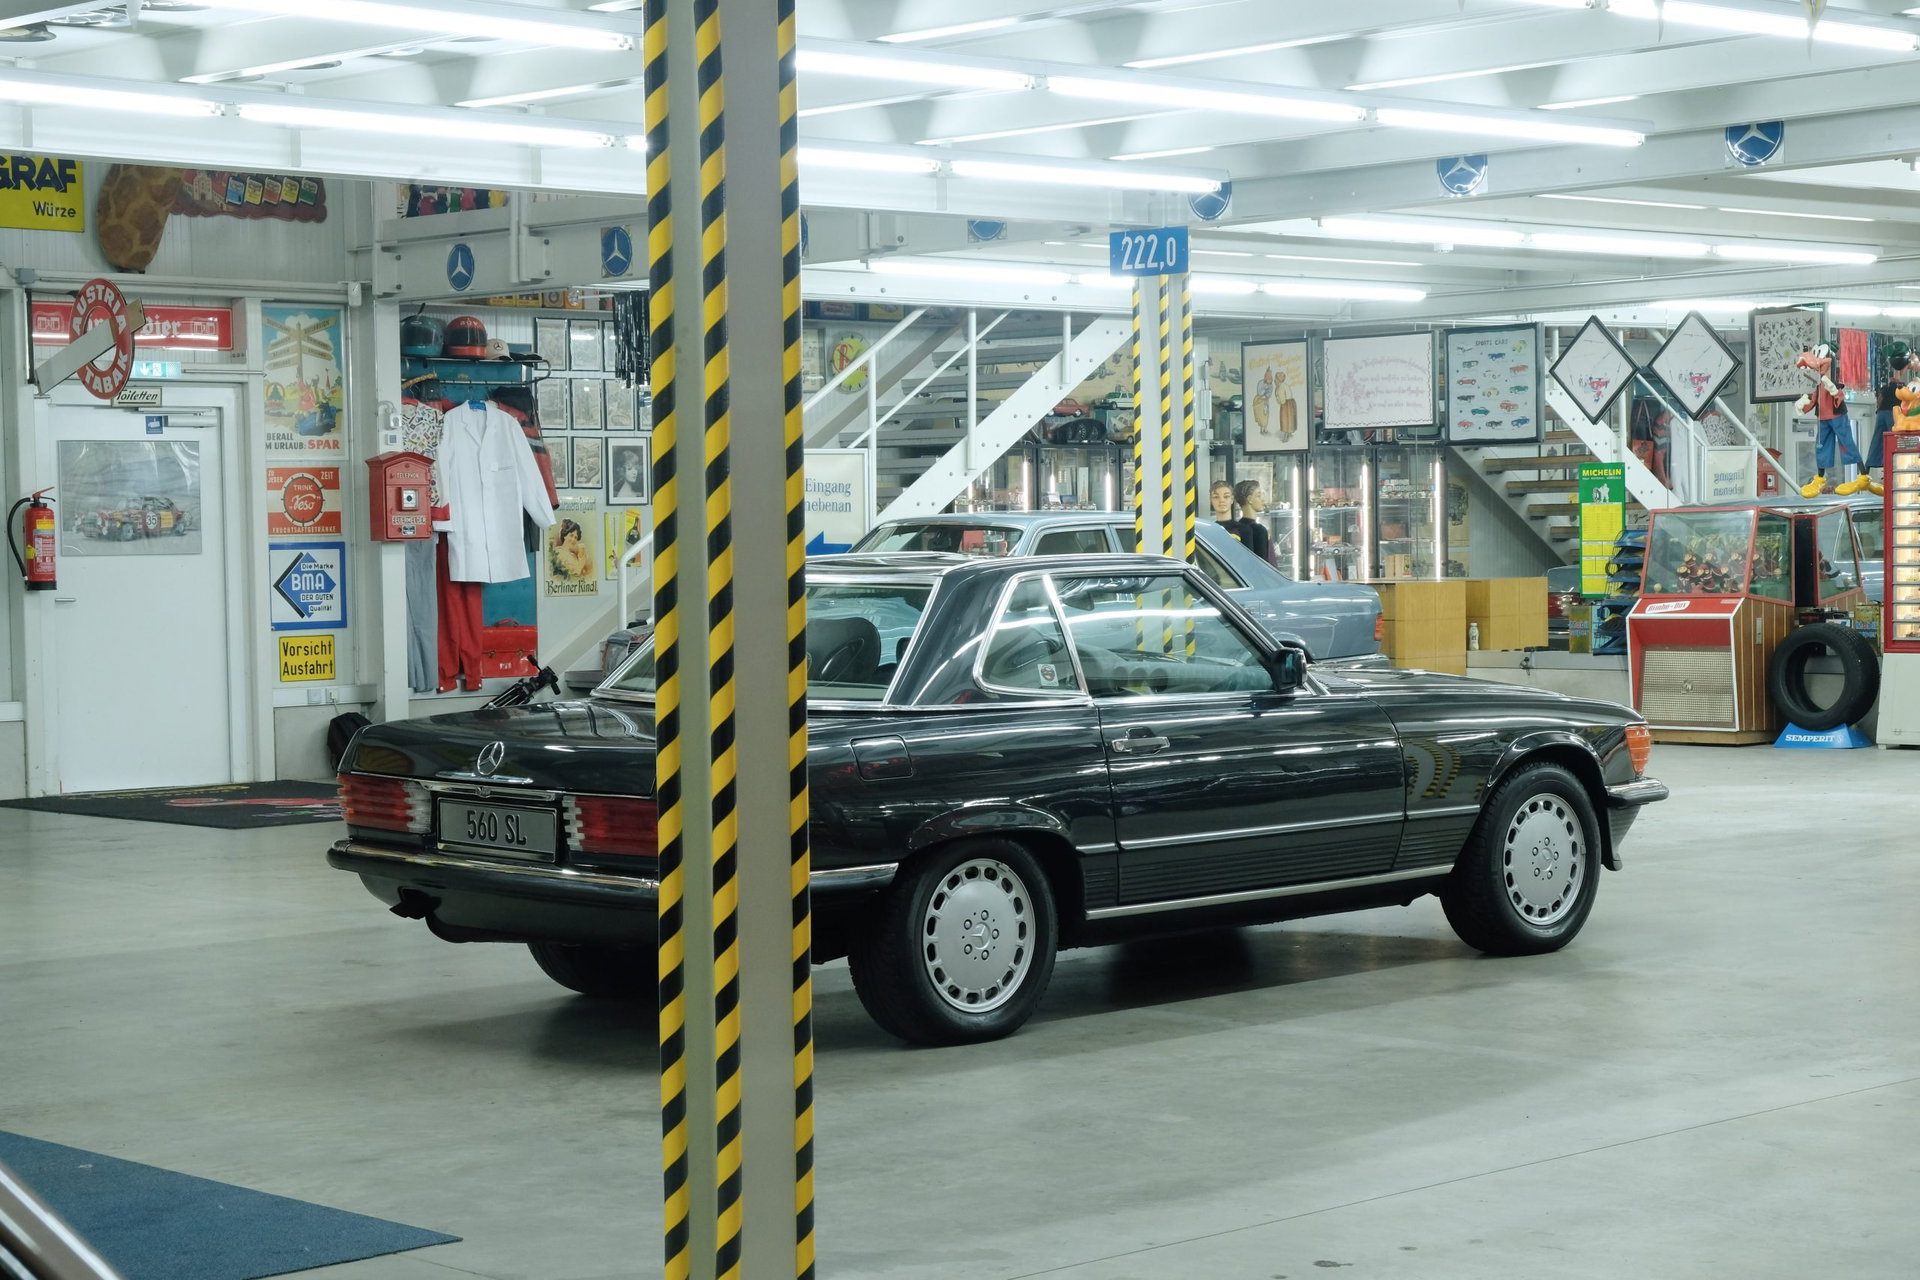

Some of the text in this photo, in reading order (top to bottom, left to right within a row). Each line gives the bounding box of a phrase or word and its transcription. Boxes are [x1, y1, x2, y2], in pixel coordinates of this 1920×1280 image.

[33, 201, 76, 218] Würze
[1121, 233, 1176, 271] 222,0
[72, 284, 126, 336] AUSTRIA
[84, 349, 130, 394] TABAK
[307, 439, 340, 450] SPAR
[320, 471, 334, 480] ZEIT
[1582, 468, 1622, 477] MICHELIN
[804, 478, 852, 498] Eingang
[146, 514, 157, 526] 35
[291, 573, 325, 591] BMA
[545, 580, 578, 595] Berliner
[315, 593, 334, 601] GUTEN
[282, 641, 332, 657] Vorsicht
[282, 659, 333, 676] Ausfahrt
[1785, 734, 1834, 743] SEMPERIT
[466, 809, 527, 845] 560 SL
